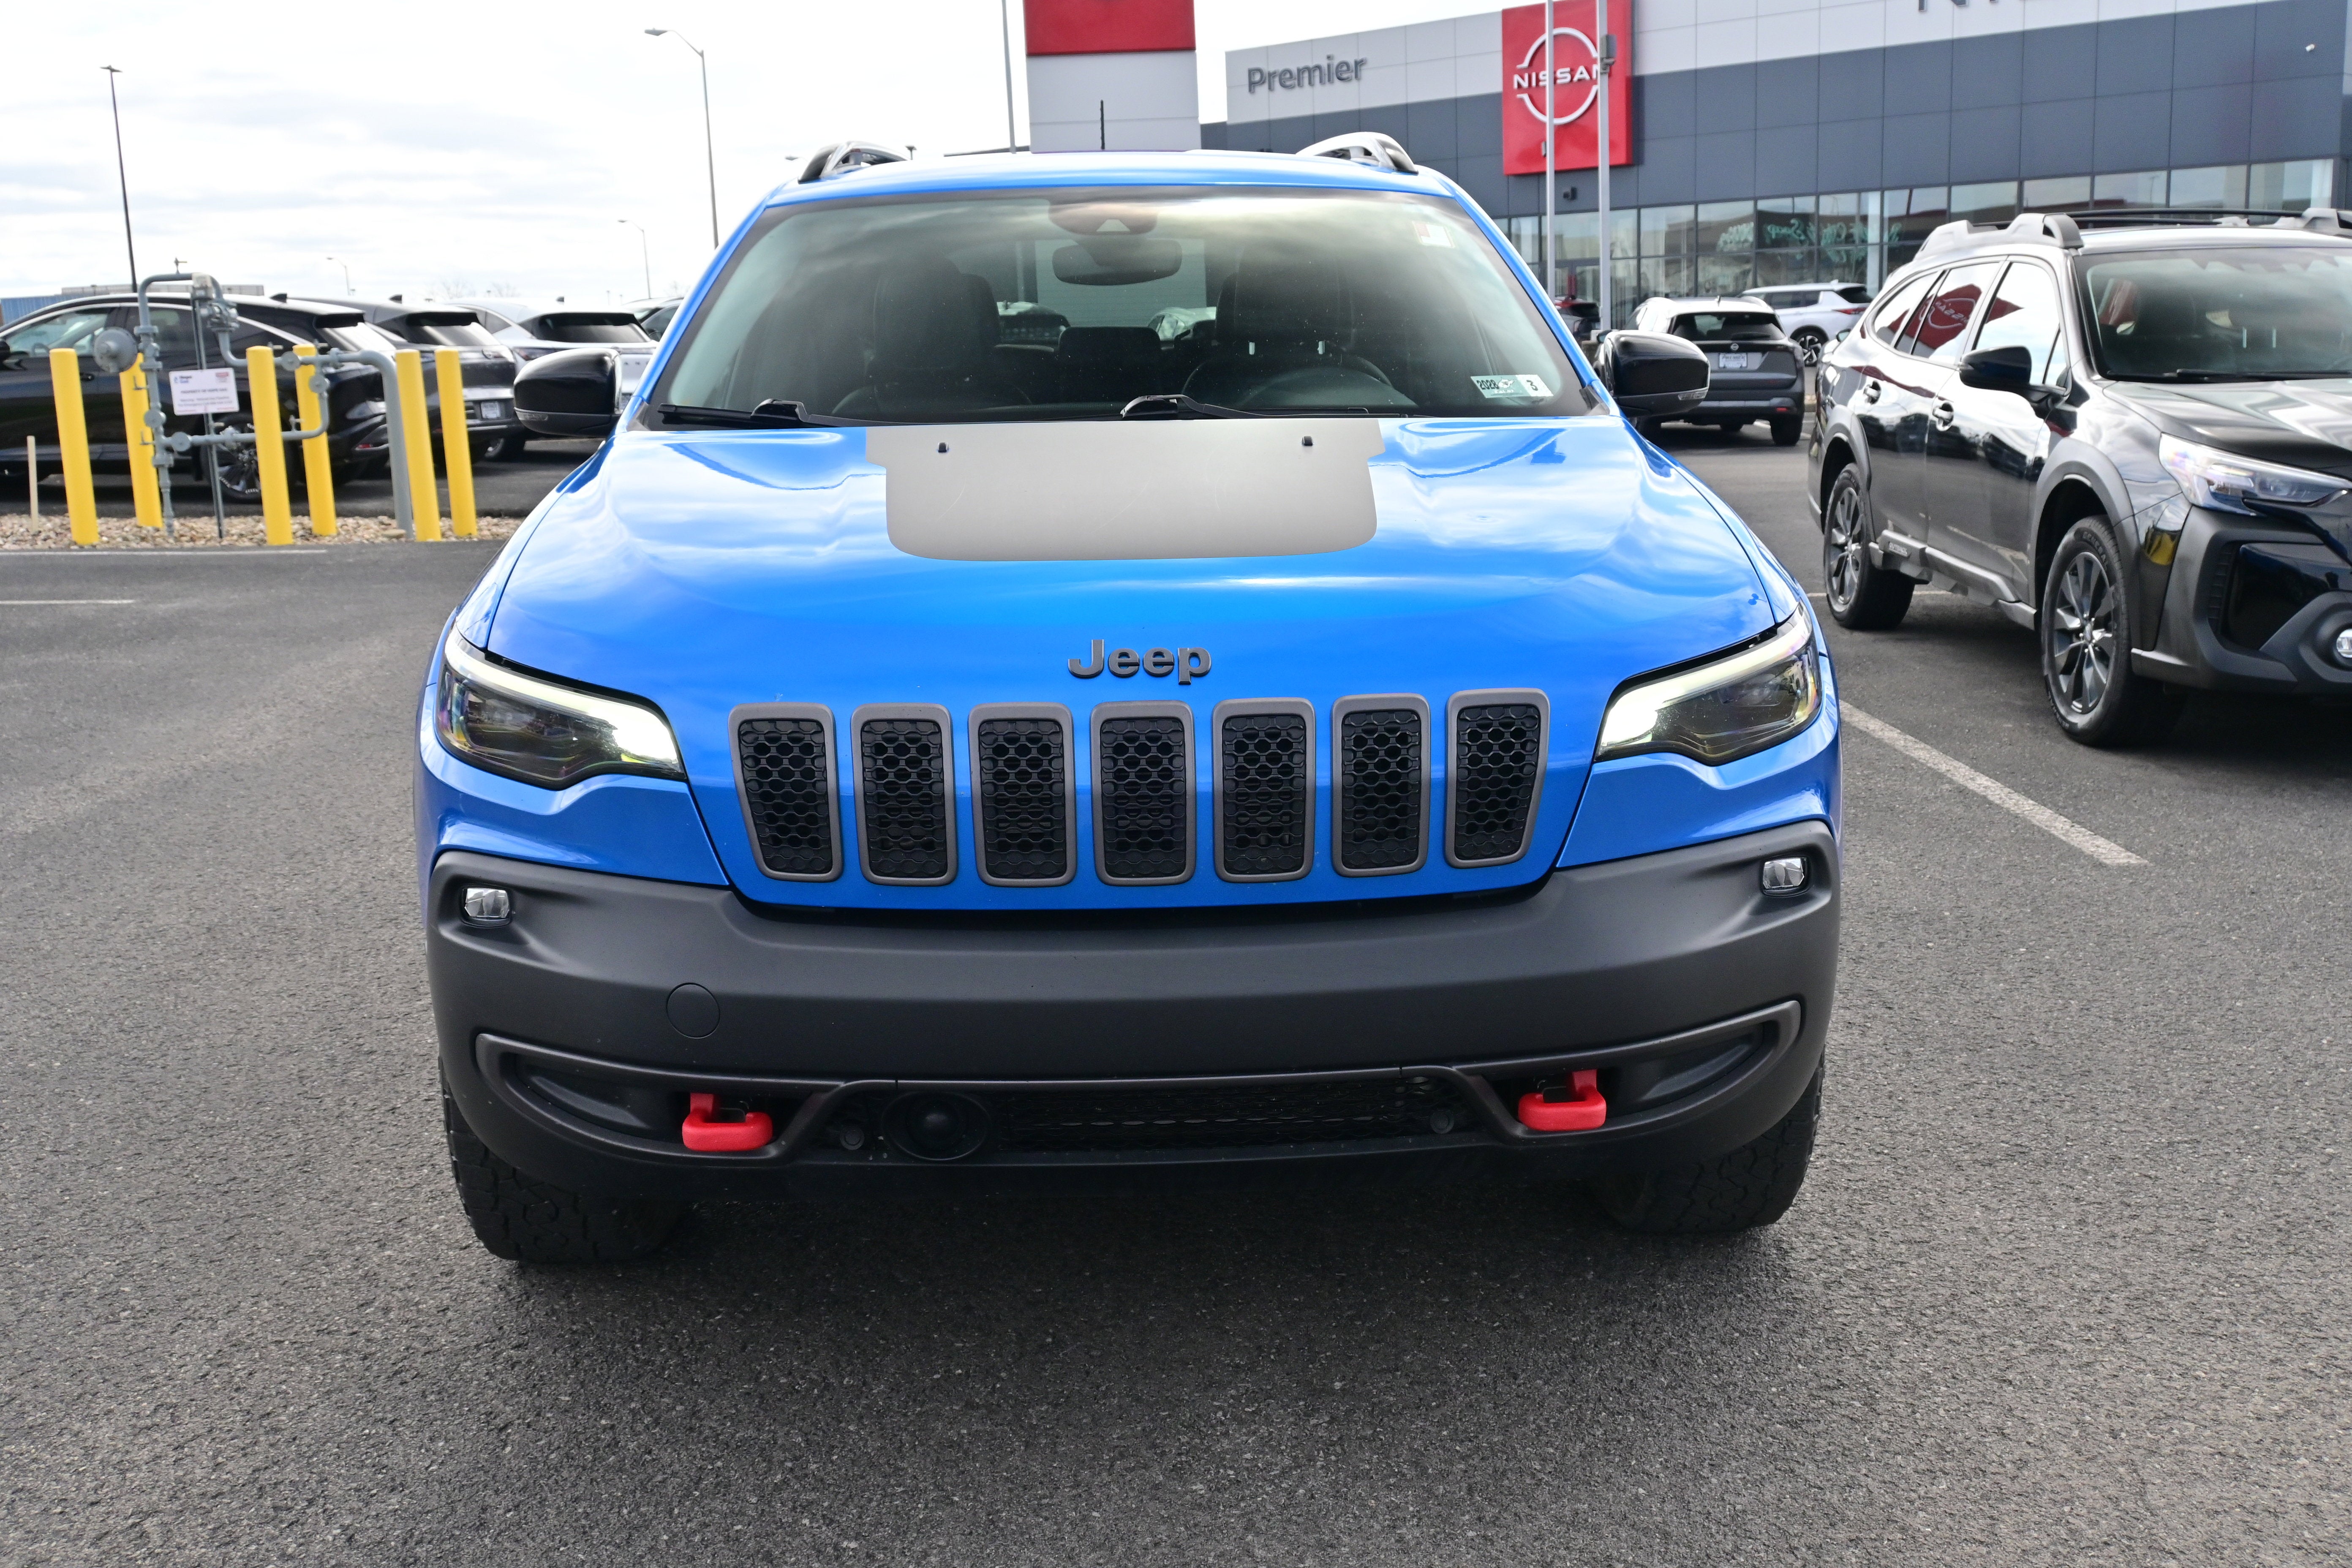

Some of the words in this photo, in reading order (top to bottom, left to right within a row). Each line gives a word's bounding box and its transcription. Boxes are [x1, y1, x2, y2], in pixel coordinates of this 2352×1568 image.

[1248, 54, 1367, 93] Premier
[1476, 379, 1500, 390] 2028
[1527, 380, 1538, 391] 3
[1067, 639, 1212, 685] Jeep
